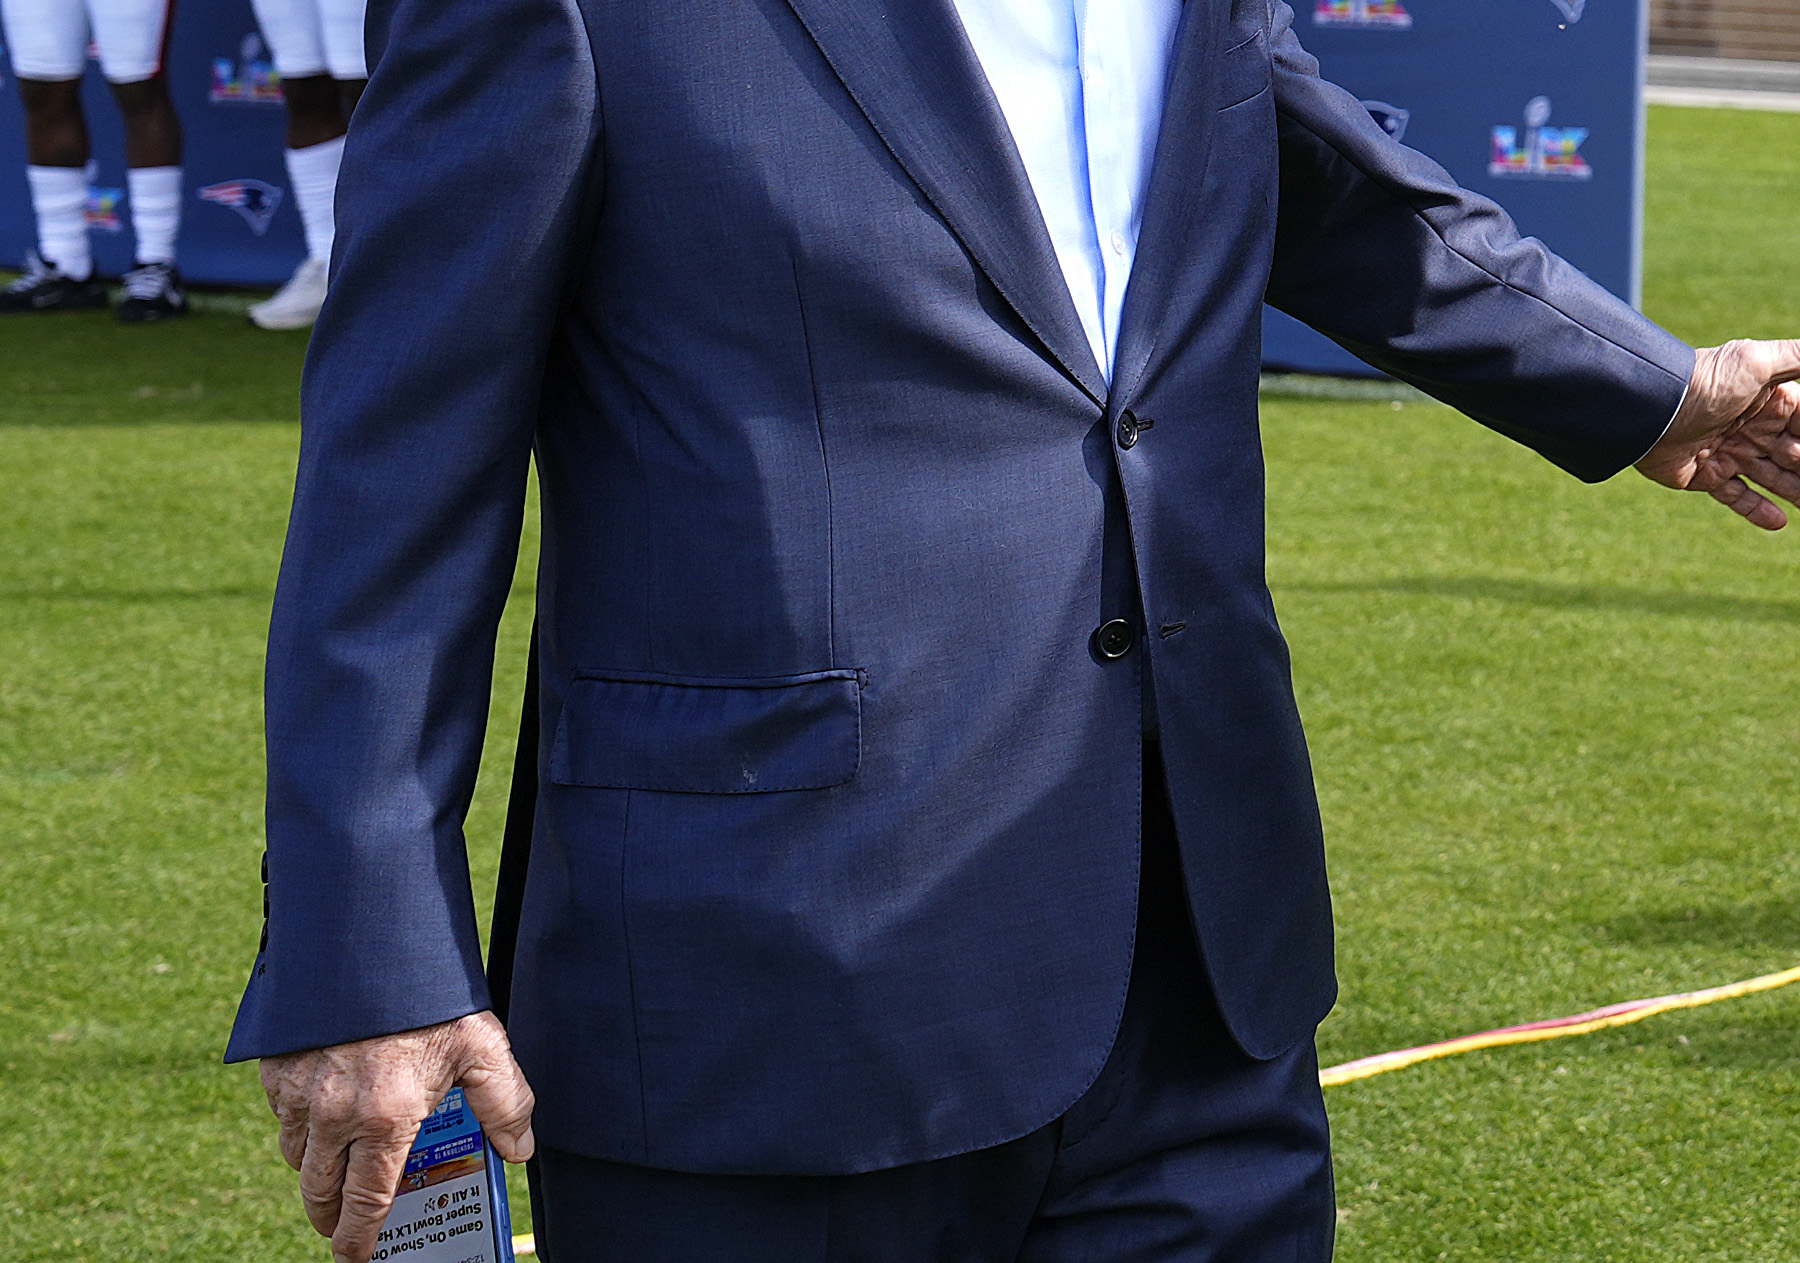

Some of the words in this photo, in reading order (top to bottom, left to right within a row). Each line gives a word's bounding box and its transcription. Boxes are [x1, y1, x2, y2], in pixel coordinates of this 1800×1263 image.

[452, 1189, 468, 1203] All
[470, 1185, 480, 1197] It
[445, 1203, 482, 1221] Super
[395, 1223, 412, 1239] LX
[413, 1214, 444, 1233] Bowl
[448, 1220, 484, 1236] Game
[425, 1231, 447, 1244] On,
[390, 1238, 425, 1256] Show
